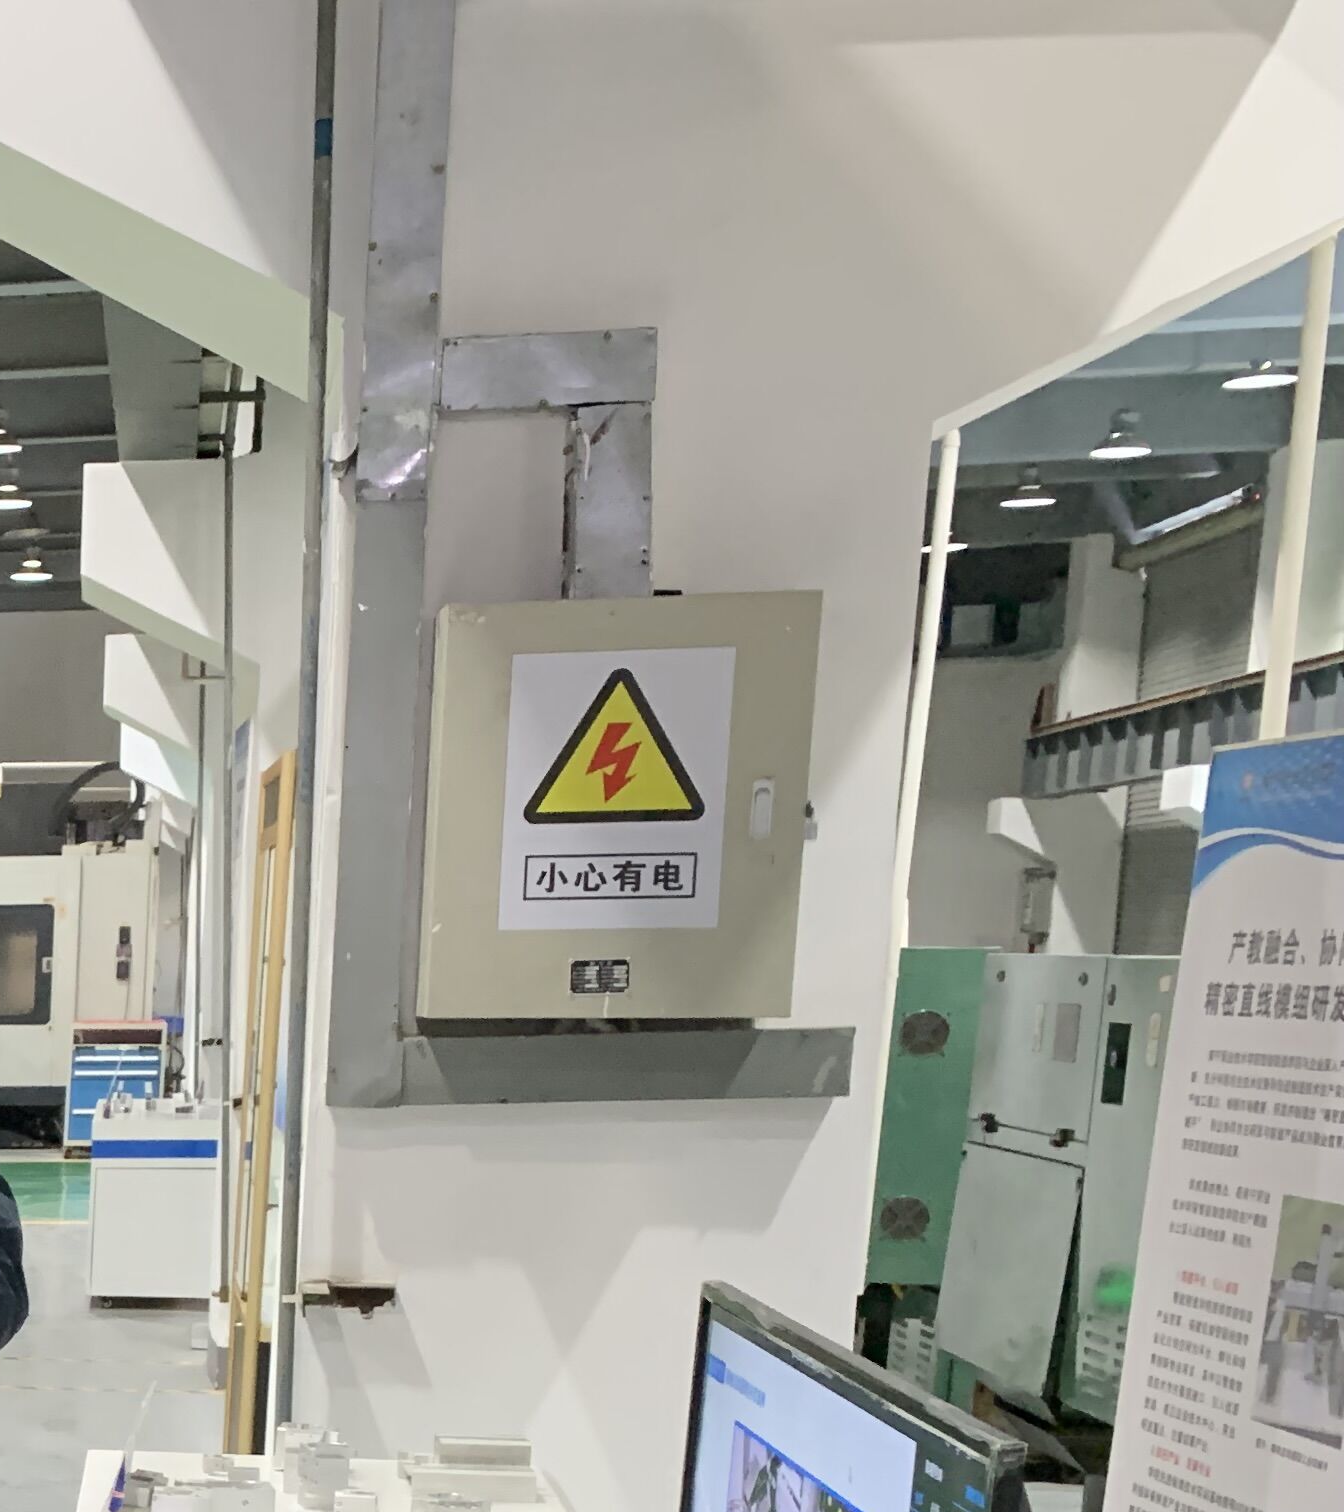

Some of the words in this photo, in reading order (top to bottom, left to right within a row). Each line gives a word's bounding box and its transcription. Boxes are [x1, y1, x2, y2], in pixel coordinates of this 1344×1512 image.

[535, 859, 684, 893] 小心有电
[1227, 928, 1344, 967] 产教融合、协
